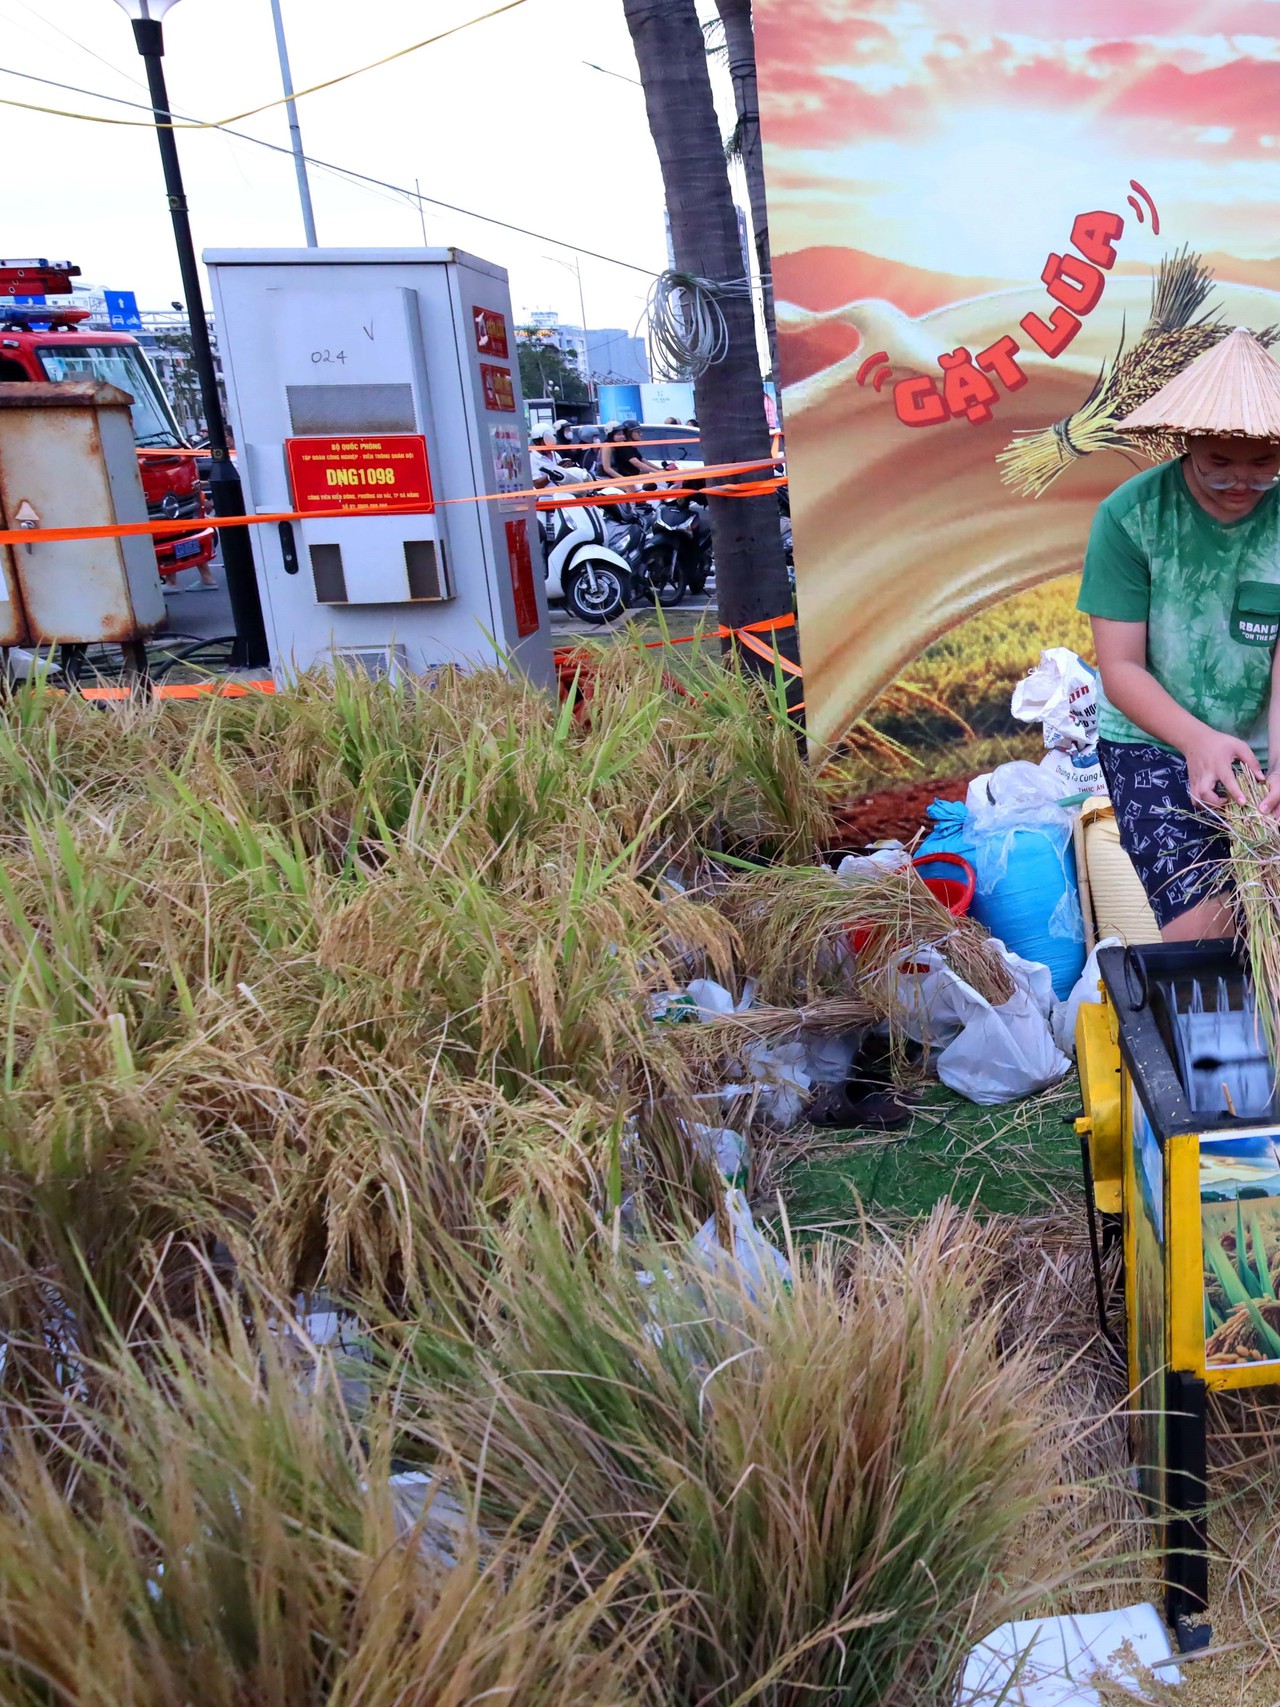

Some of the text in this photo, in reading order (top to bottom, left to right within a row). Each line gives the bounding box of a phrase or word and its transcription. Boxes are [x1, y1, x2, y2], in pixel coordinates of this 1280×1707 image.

[892, 210, 1125, 428] GẶT LÚA
[311, 349, 347, 365] 024
[331, 441, 382, 451] BỘ QUỐC PHÒNG
[326, 468, 395, 486] DNG1098
